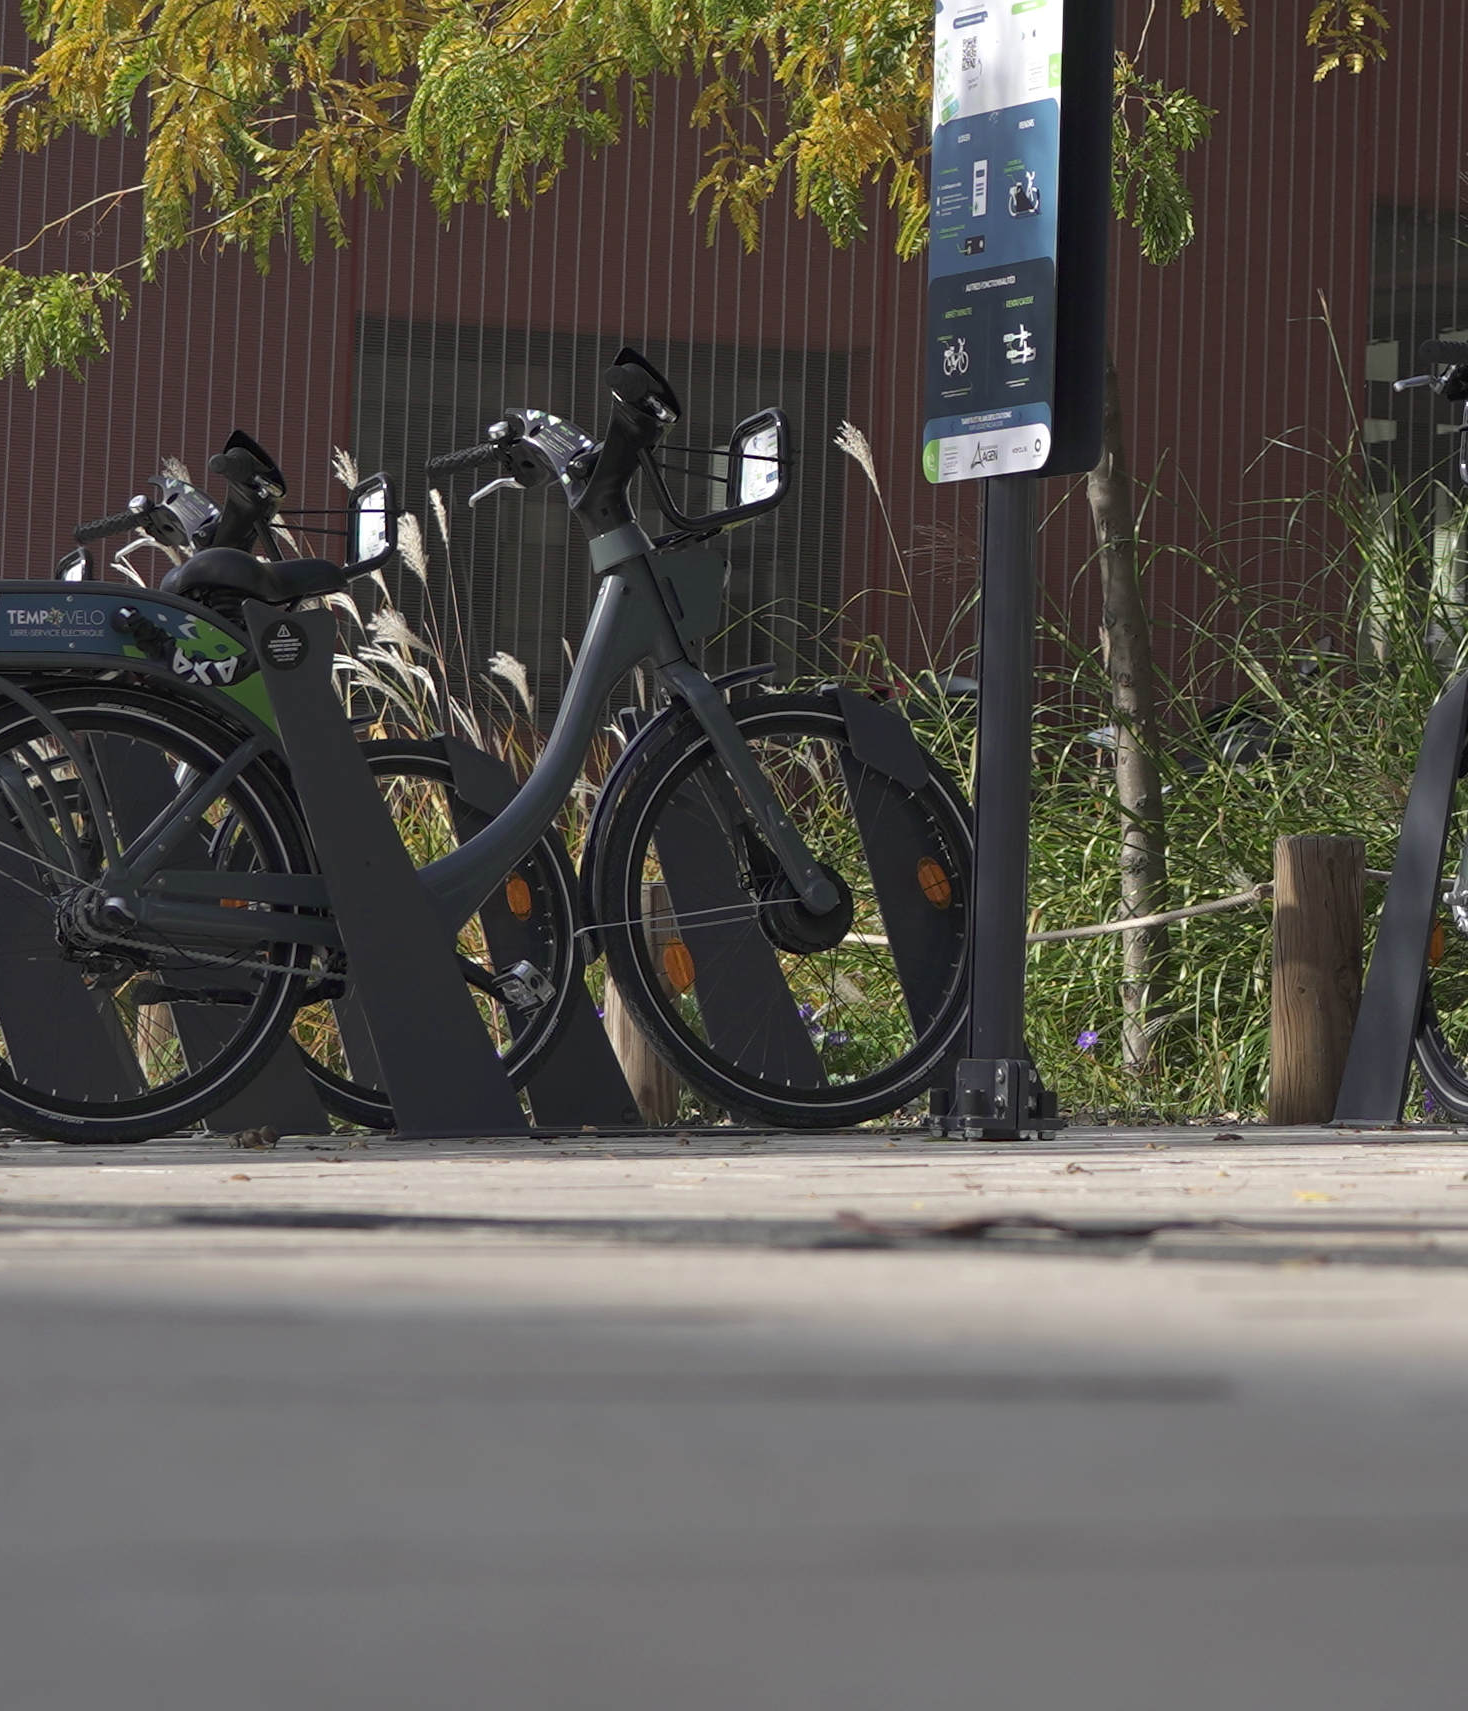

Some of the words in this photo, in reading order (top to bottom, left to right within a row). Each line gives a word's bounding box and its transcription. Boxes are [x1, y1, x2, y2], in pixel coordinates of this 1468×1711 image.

[982, 450, 998, 462] AGEN
[65, 609, 105, 625] VELO
[10, 629, 60, 637] LIBRE-SERVICE
[61, 627, 105, 638] ÉLECTRIQUE
